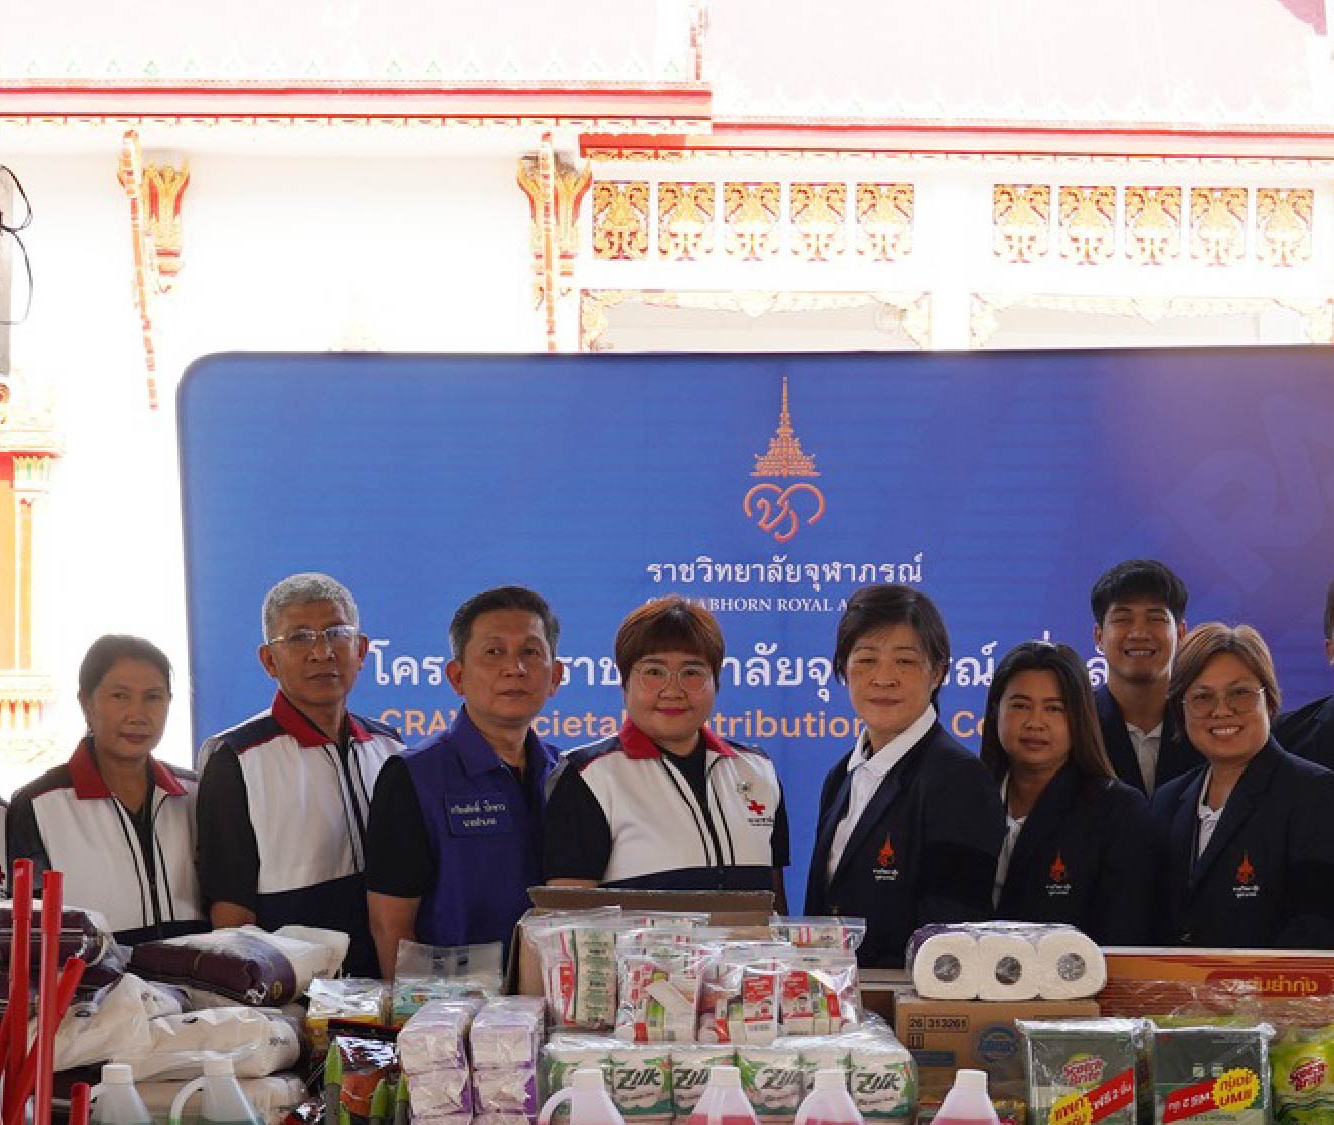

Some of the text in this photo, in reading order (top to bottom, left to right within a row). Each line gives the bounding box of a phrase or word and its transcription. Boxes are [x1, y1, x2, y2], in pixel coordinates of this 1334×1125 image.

[646, 554, 923, 592] ราชวิทยาลัยจุฬาภรณ์
[777, 598, 834, 612] ROYAL
